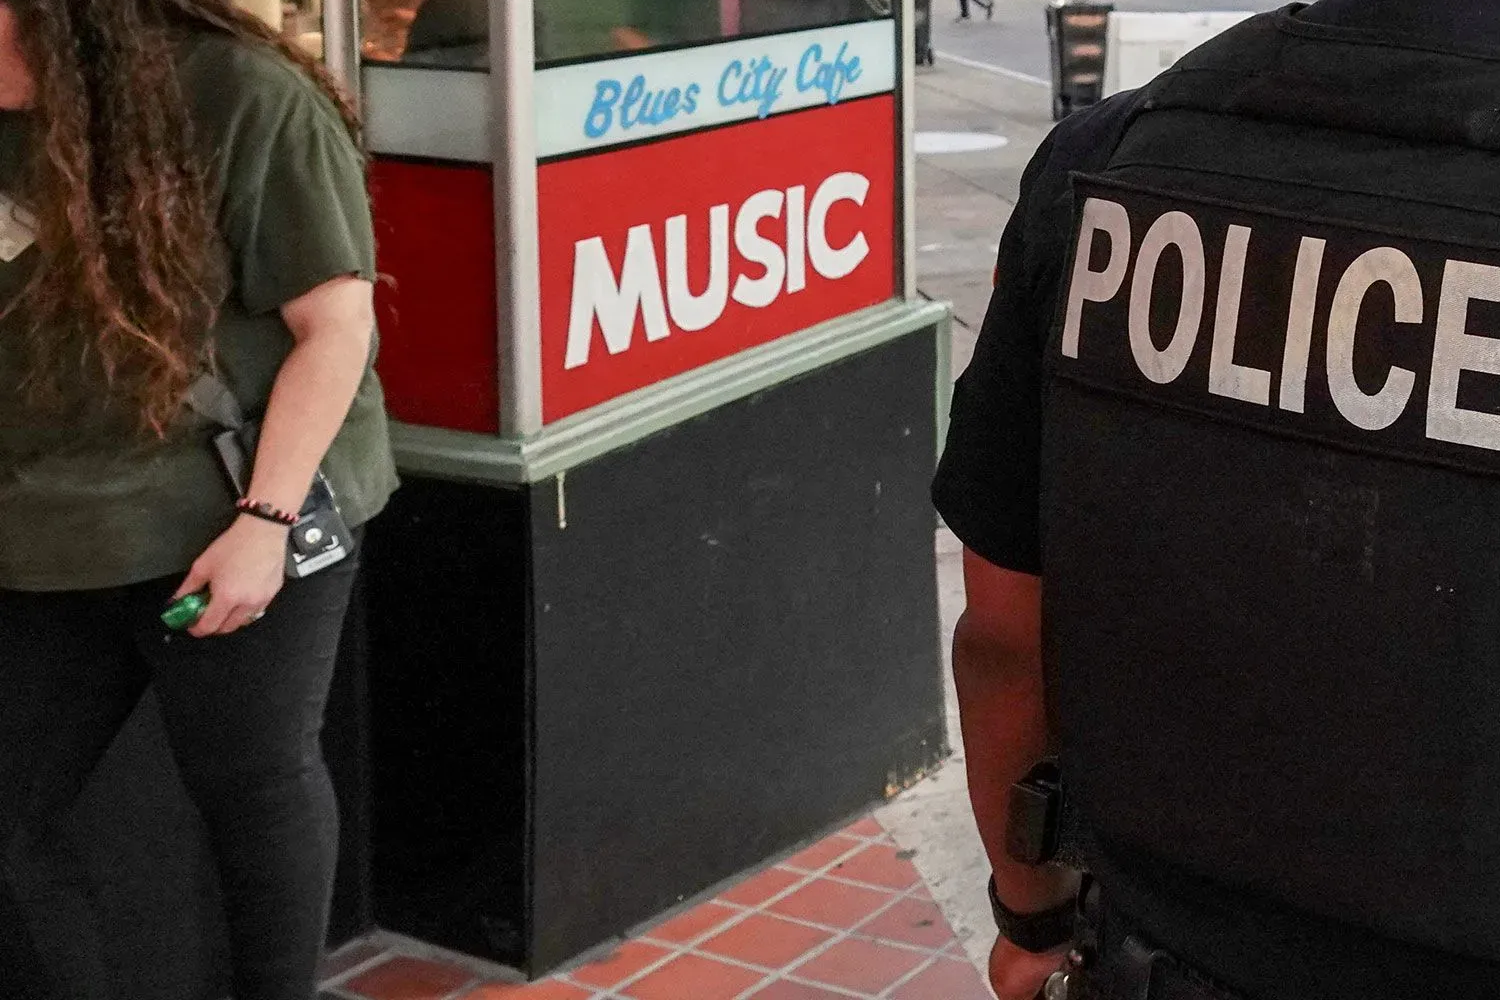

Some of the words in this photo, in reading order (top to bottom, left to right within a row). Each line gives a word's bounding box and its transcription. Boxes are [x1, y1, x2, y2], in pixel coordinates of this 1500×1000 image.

[583, 74, 700, 139] Blues
[717, 54, 788, 118] City
[796, 41, 863, 105] Cafe
[564, 171, 870, 370] MUSIC
